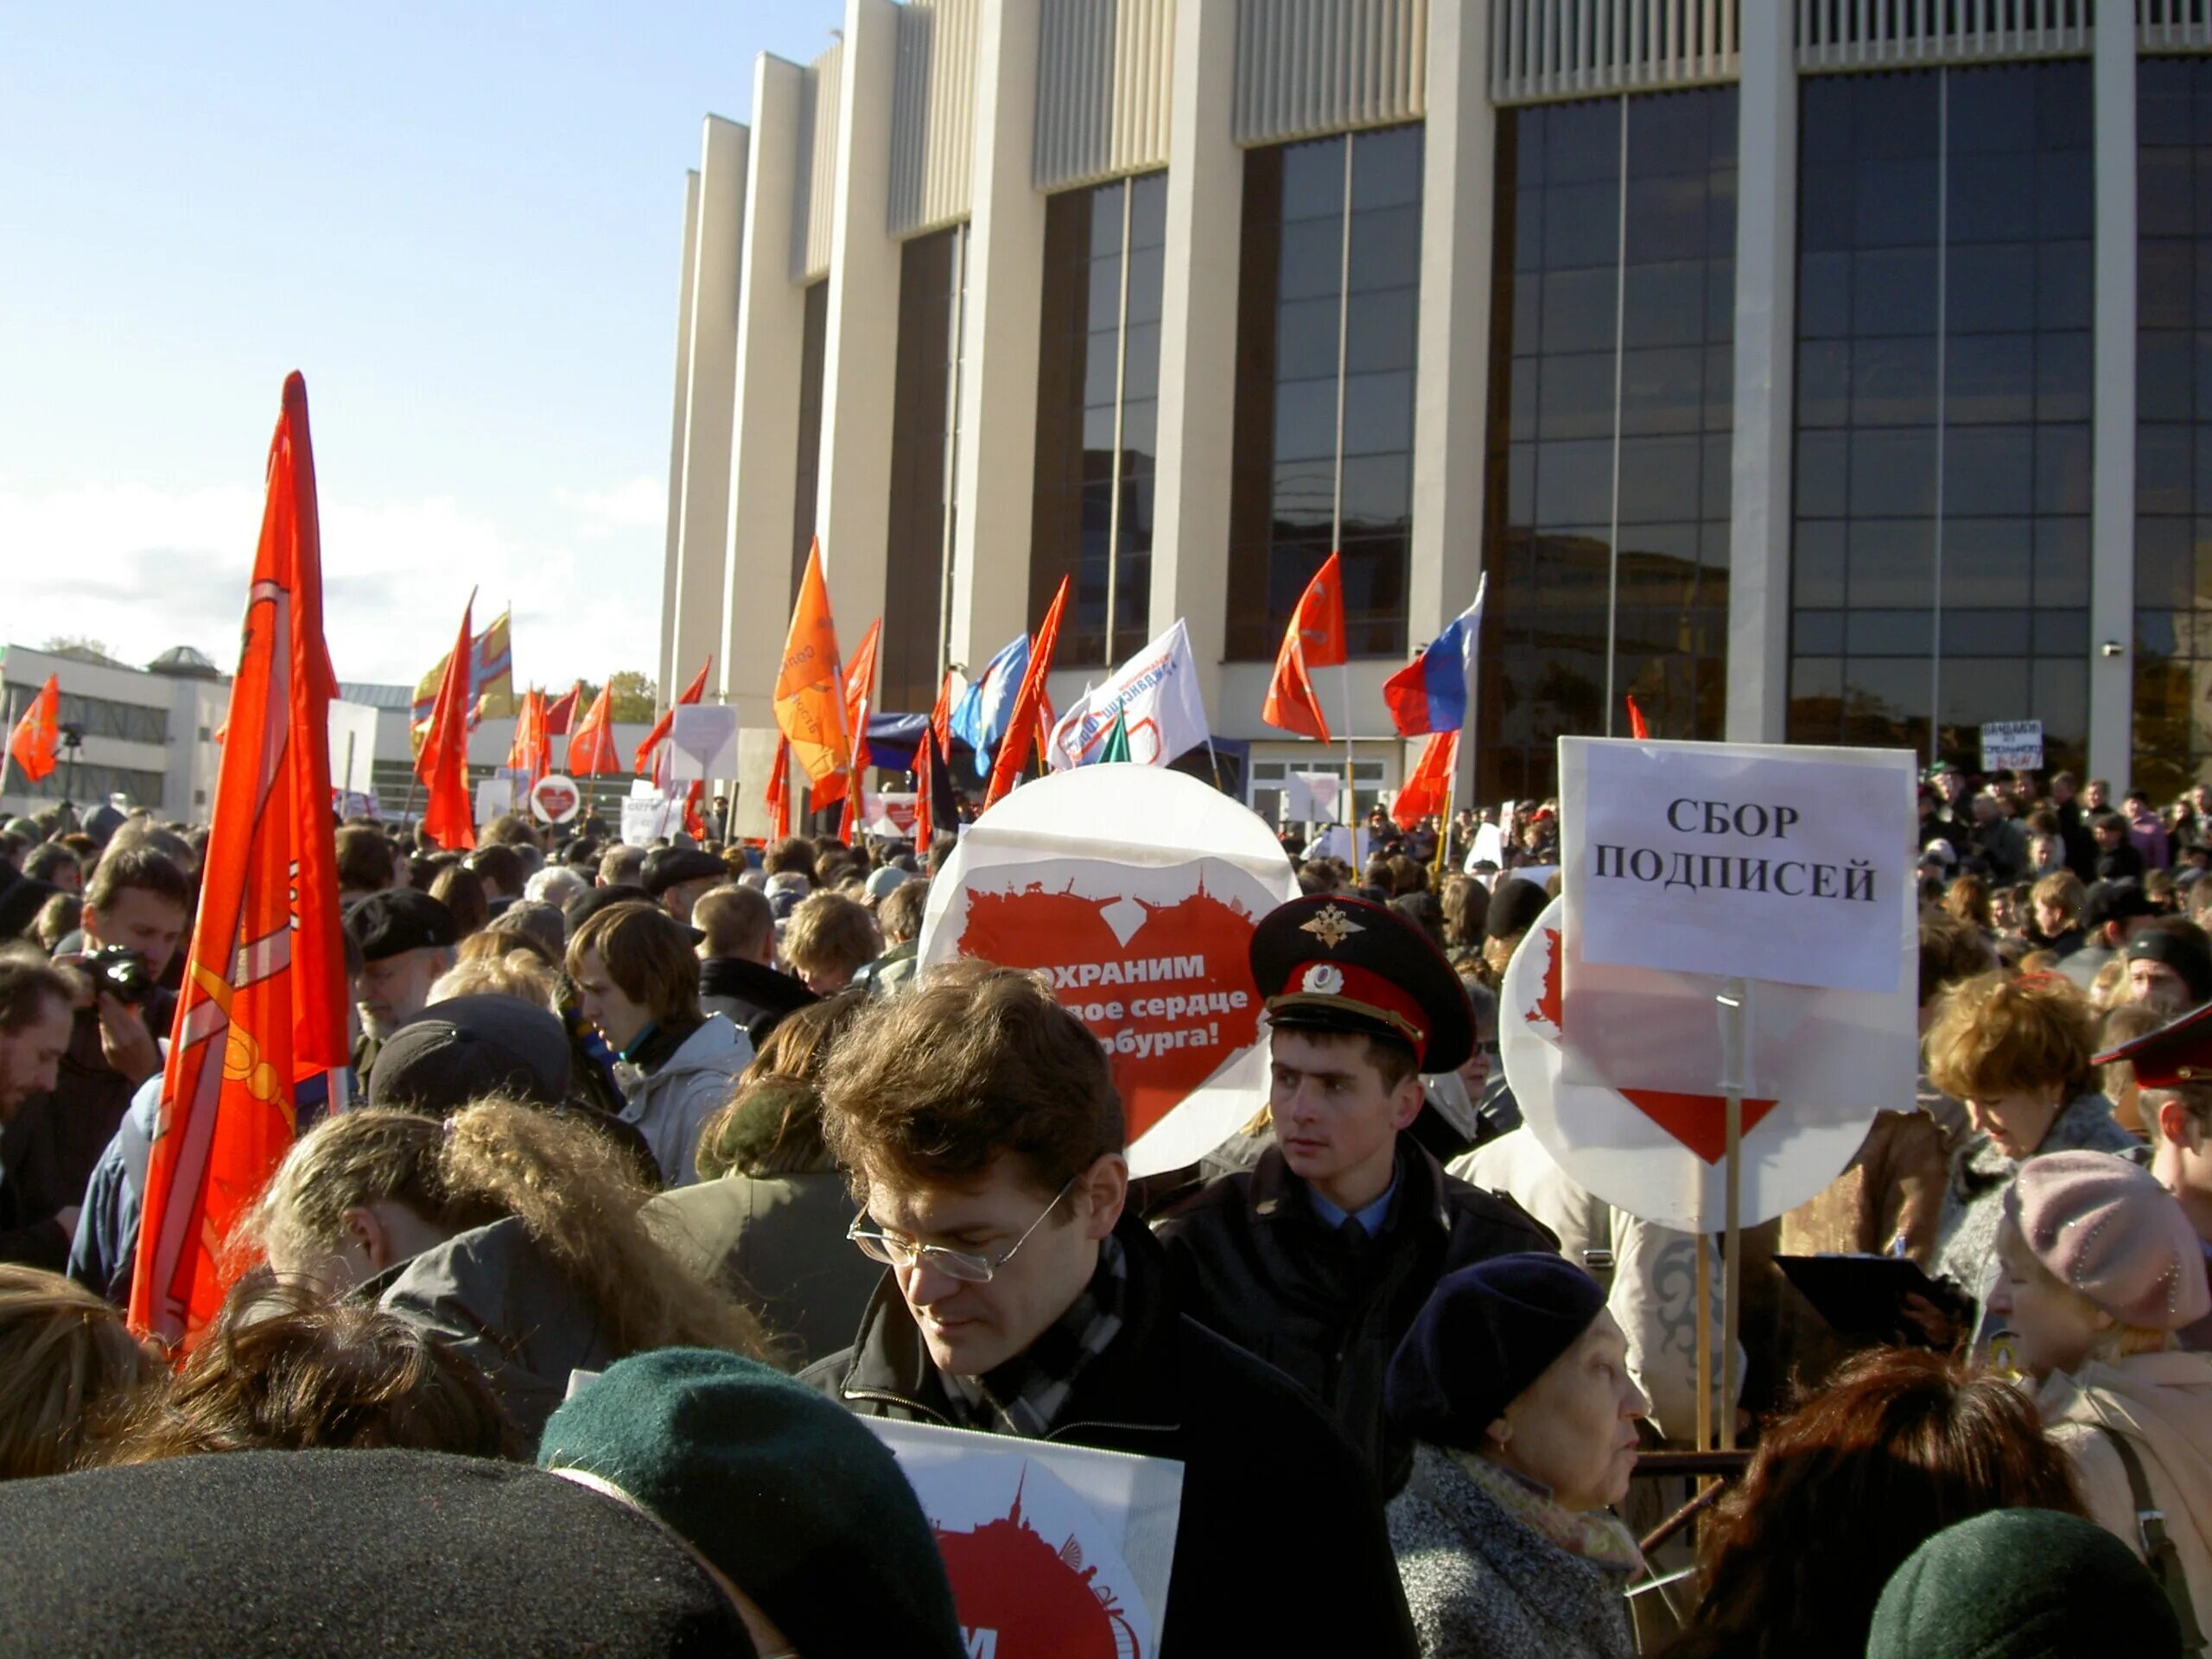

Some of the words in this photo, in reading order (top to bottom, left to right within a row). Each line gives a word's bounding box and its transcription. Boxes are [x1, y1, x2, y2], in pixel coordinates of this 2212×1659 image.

[1667, 798, 1799, 839] СБОР
[1594, 843, 1878, 902] ПОДПИСЕЙ
[1036, 954, 1205, 989] ОХРАНИМ
[1065, 1001, 1124, 1021] вое
[1130, 990, 1249, 1020] сердце
[1098, 1021, 1219, 1058] рбурга!
